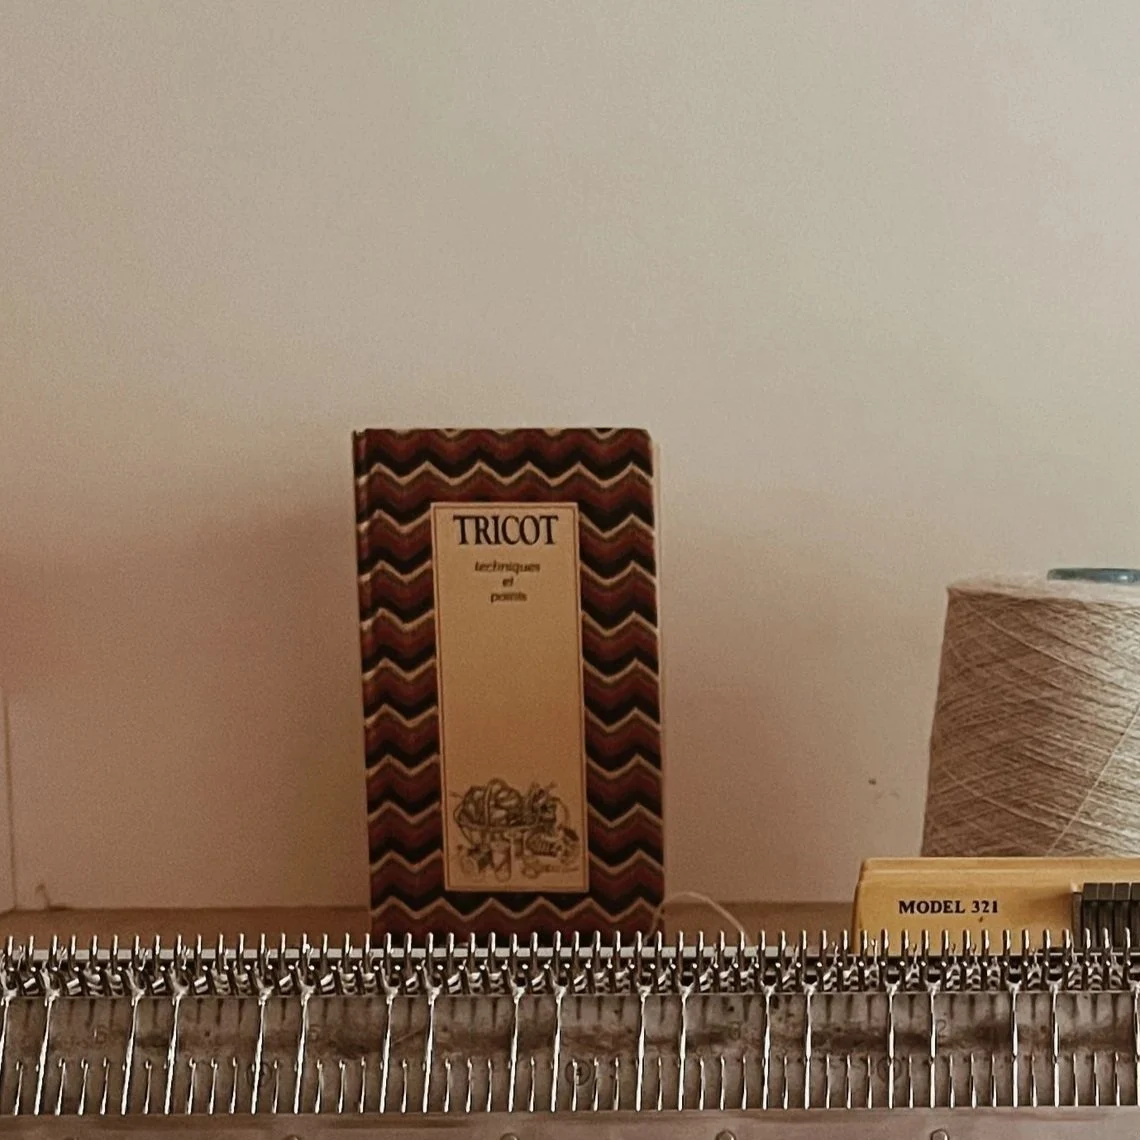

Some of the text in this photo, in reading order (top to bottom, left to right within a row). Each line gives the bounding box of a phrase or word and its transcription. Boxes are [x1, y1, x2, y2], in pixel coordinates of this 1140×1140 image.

[453, 515, 559, 545] TRICOT
[898, 900, 998, 914] MODEL 321
